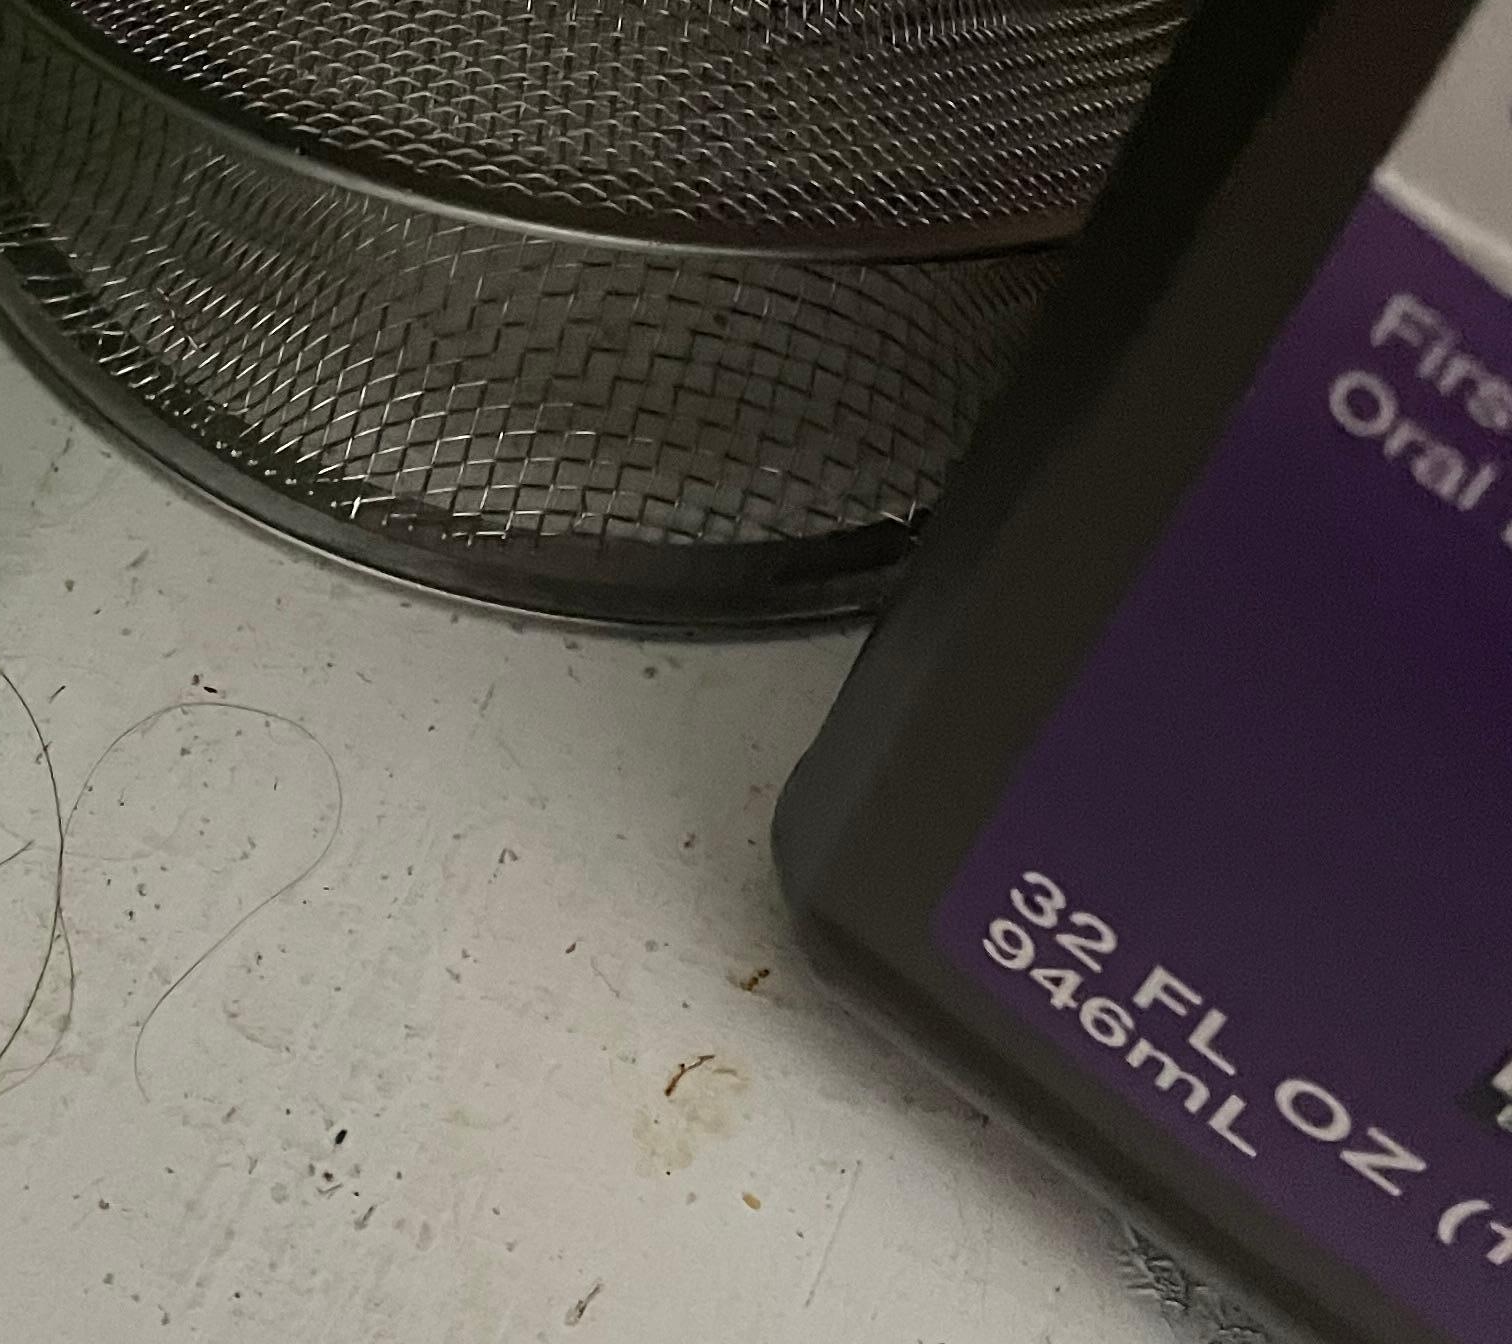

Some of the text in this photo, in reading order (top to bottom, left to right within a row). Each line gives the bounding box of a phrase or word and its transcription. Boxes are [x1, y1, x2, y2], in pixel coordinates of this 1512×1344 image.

[1328, 369, 1496, 512] Oral
[982, 918, 1257, 1157] 946mL
[1009, 870, 1118, 973] 32
[1132, 964, 1236, 1076] FL
[1274, 1077, 1427, 1197] OZ
